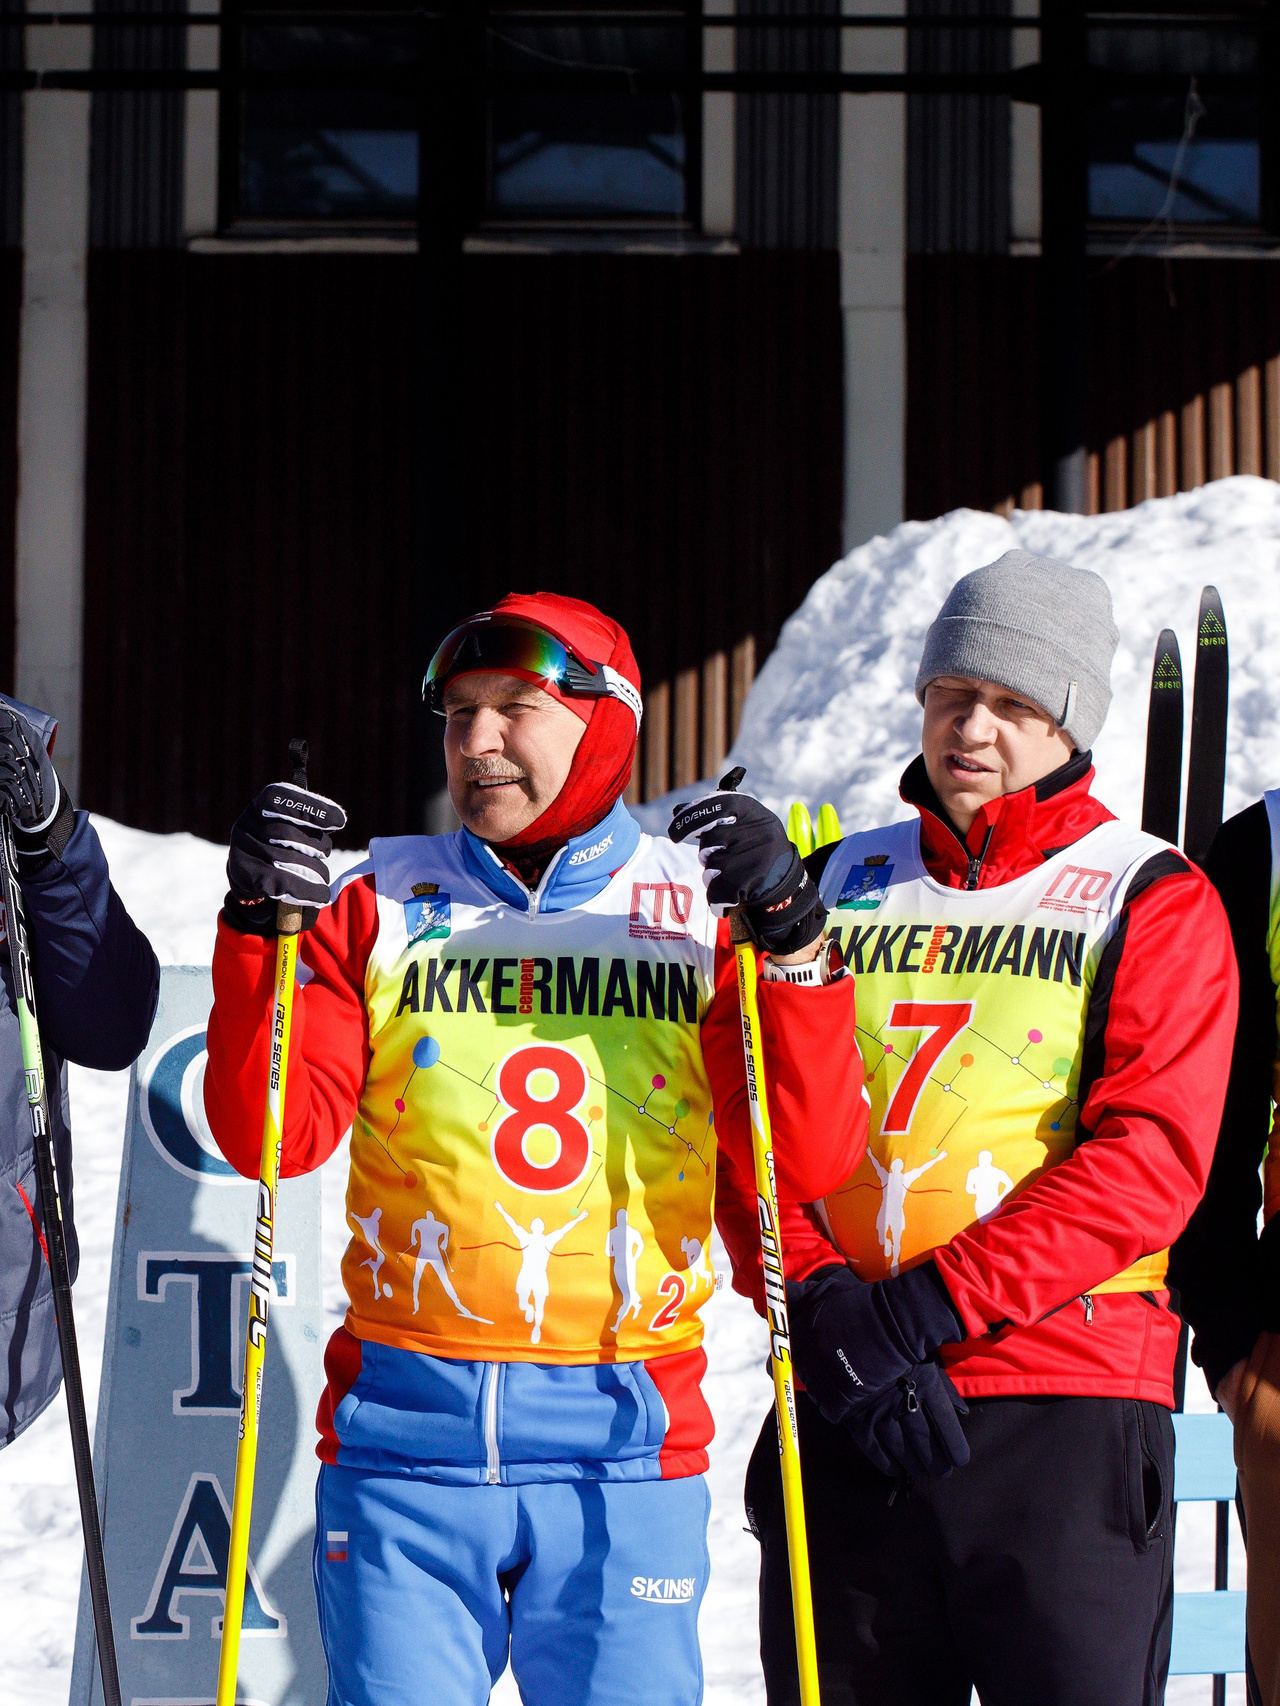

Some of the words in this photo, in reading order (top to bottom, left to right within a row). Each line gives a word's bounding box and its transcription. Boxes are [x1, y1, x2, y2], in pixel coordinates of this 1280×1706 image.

[1199, 637, 1226, 646] 28/610
[1153, 681, 1181, 690] 28/610
[570, 831, 614, 864] SKINSK
[629, 882, 694, 924] ГТО
[1045, 864, 1113, 901] ГТО
[921, 925, 949, 974] cement
[395, 956, 699, 1024] AKKERMANN
[519, 957, 535, 1015] cement
[275, 1002, 286, 1038] race
[742, 1014, 753, 1050] race
[270, 1041, 283, 1091] series
[746, 1053, 758, 1102] series
[880, 1000, 976, 1135] 7
[490, 1042, 593, 1195] 8
[648, 1271, 687, 1332] 2
[836, 1348, 864, 1388] SPORT
[746, 1506, 760, 1534] NIKE
[629, 1576, 697, 1600] SKINSK
